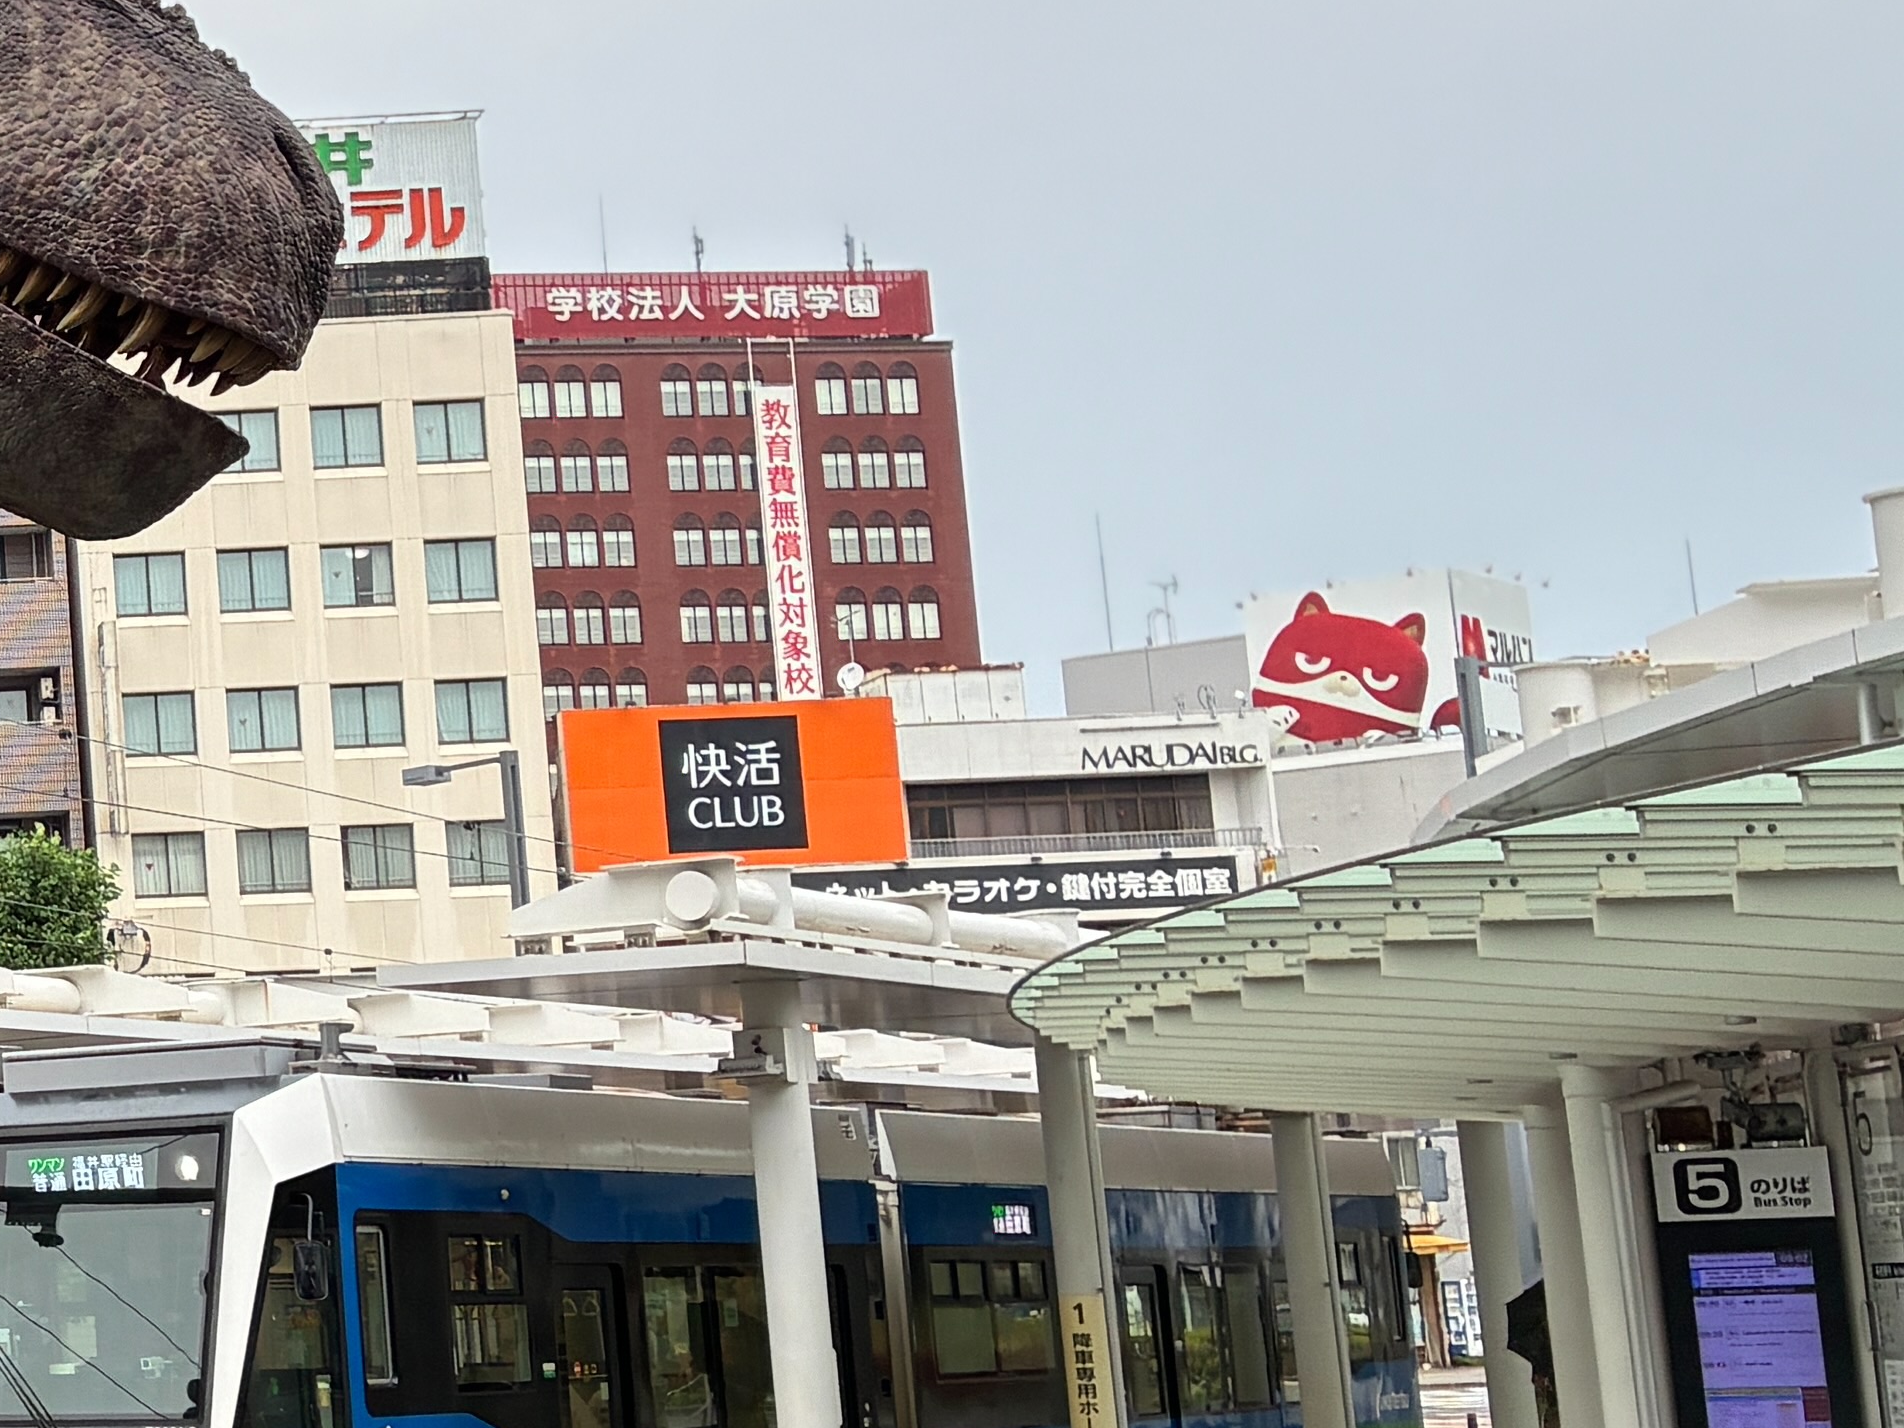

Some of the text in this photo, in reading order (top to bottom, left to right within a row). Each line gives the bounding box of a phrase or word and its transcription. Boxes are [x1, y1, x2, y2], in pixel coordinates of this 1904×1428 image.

[339, 186, 466, 252] テル
[546, 284, 880, 322] 学校法人 大原学園
[760, 398, 816, 695] 教育費無償化対象校
[681, 740, 781, 789] 快活
[1081, 741, 1218, 771] MARUDAI
[688, 795, 785, 829] CLUB
[28, 1157, 65, 1173] ワンマン
[72, 1167, 145, 1192] 田原町
[1686, 1164, 1729, 1209] 5
[1750, 1176, 1810, 1195] のりば
[1754, 1195, 1812, 1208] Bus Stop
[1072, 1302, 1085, 1325] 1
